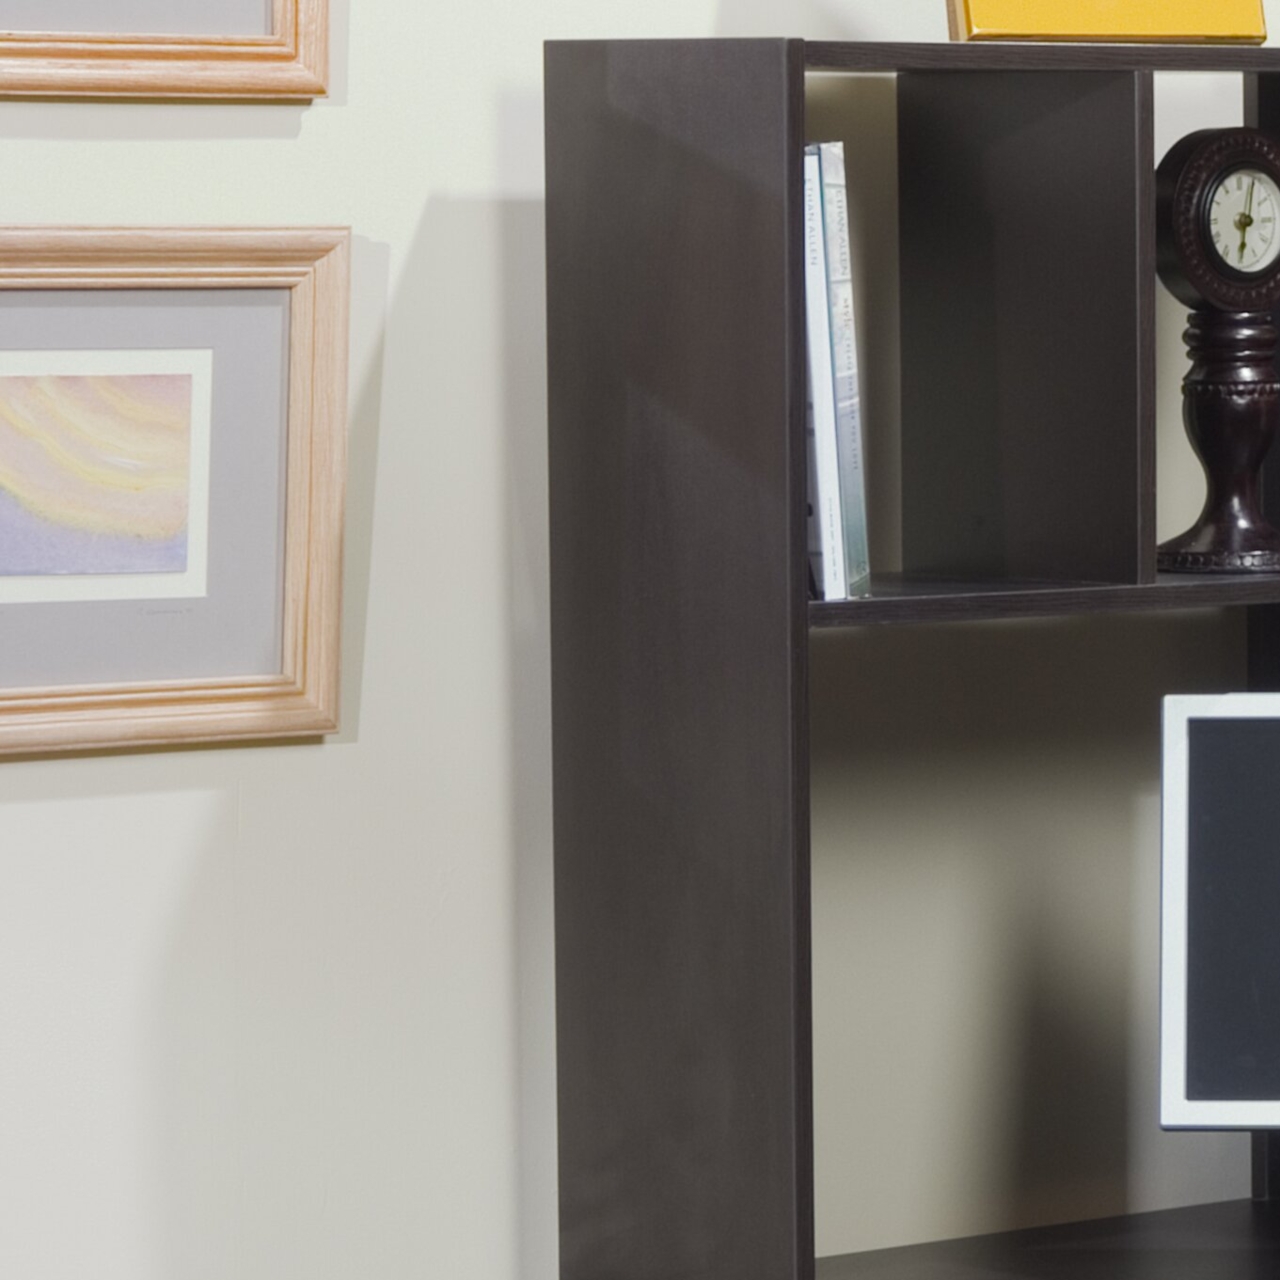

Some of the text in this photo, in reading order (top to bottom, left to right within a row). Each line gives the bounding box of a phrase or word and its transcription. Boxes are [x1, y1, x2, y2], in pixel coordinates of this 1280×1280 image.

[809, 225, 818, 267] ALLEN
[836, 190, 848, 276] ETHAN ALLEN
